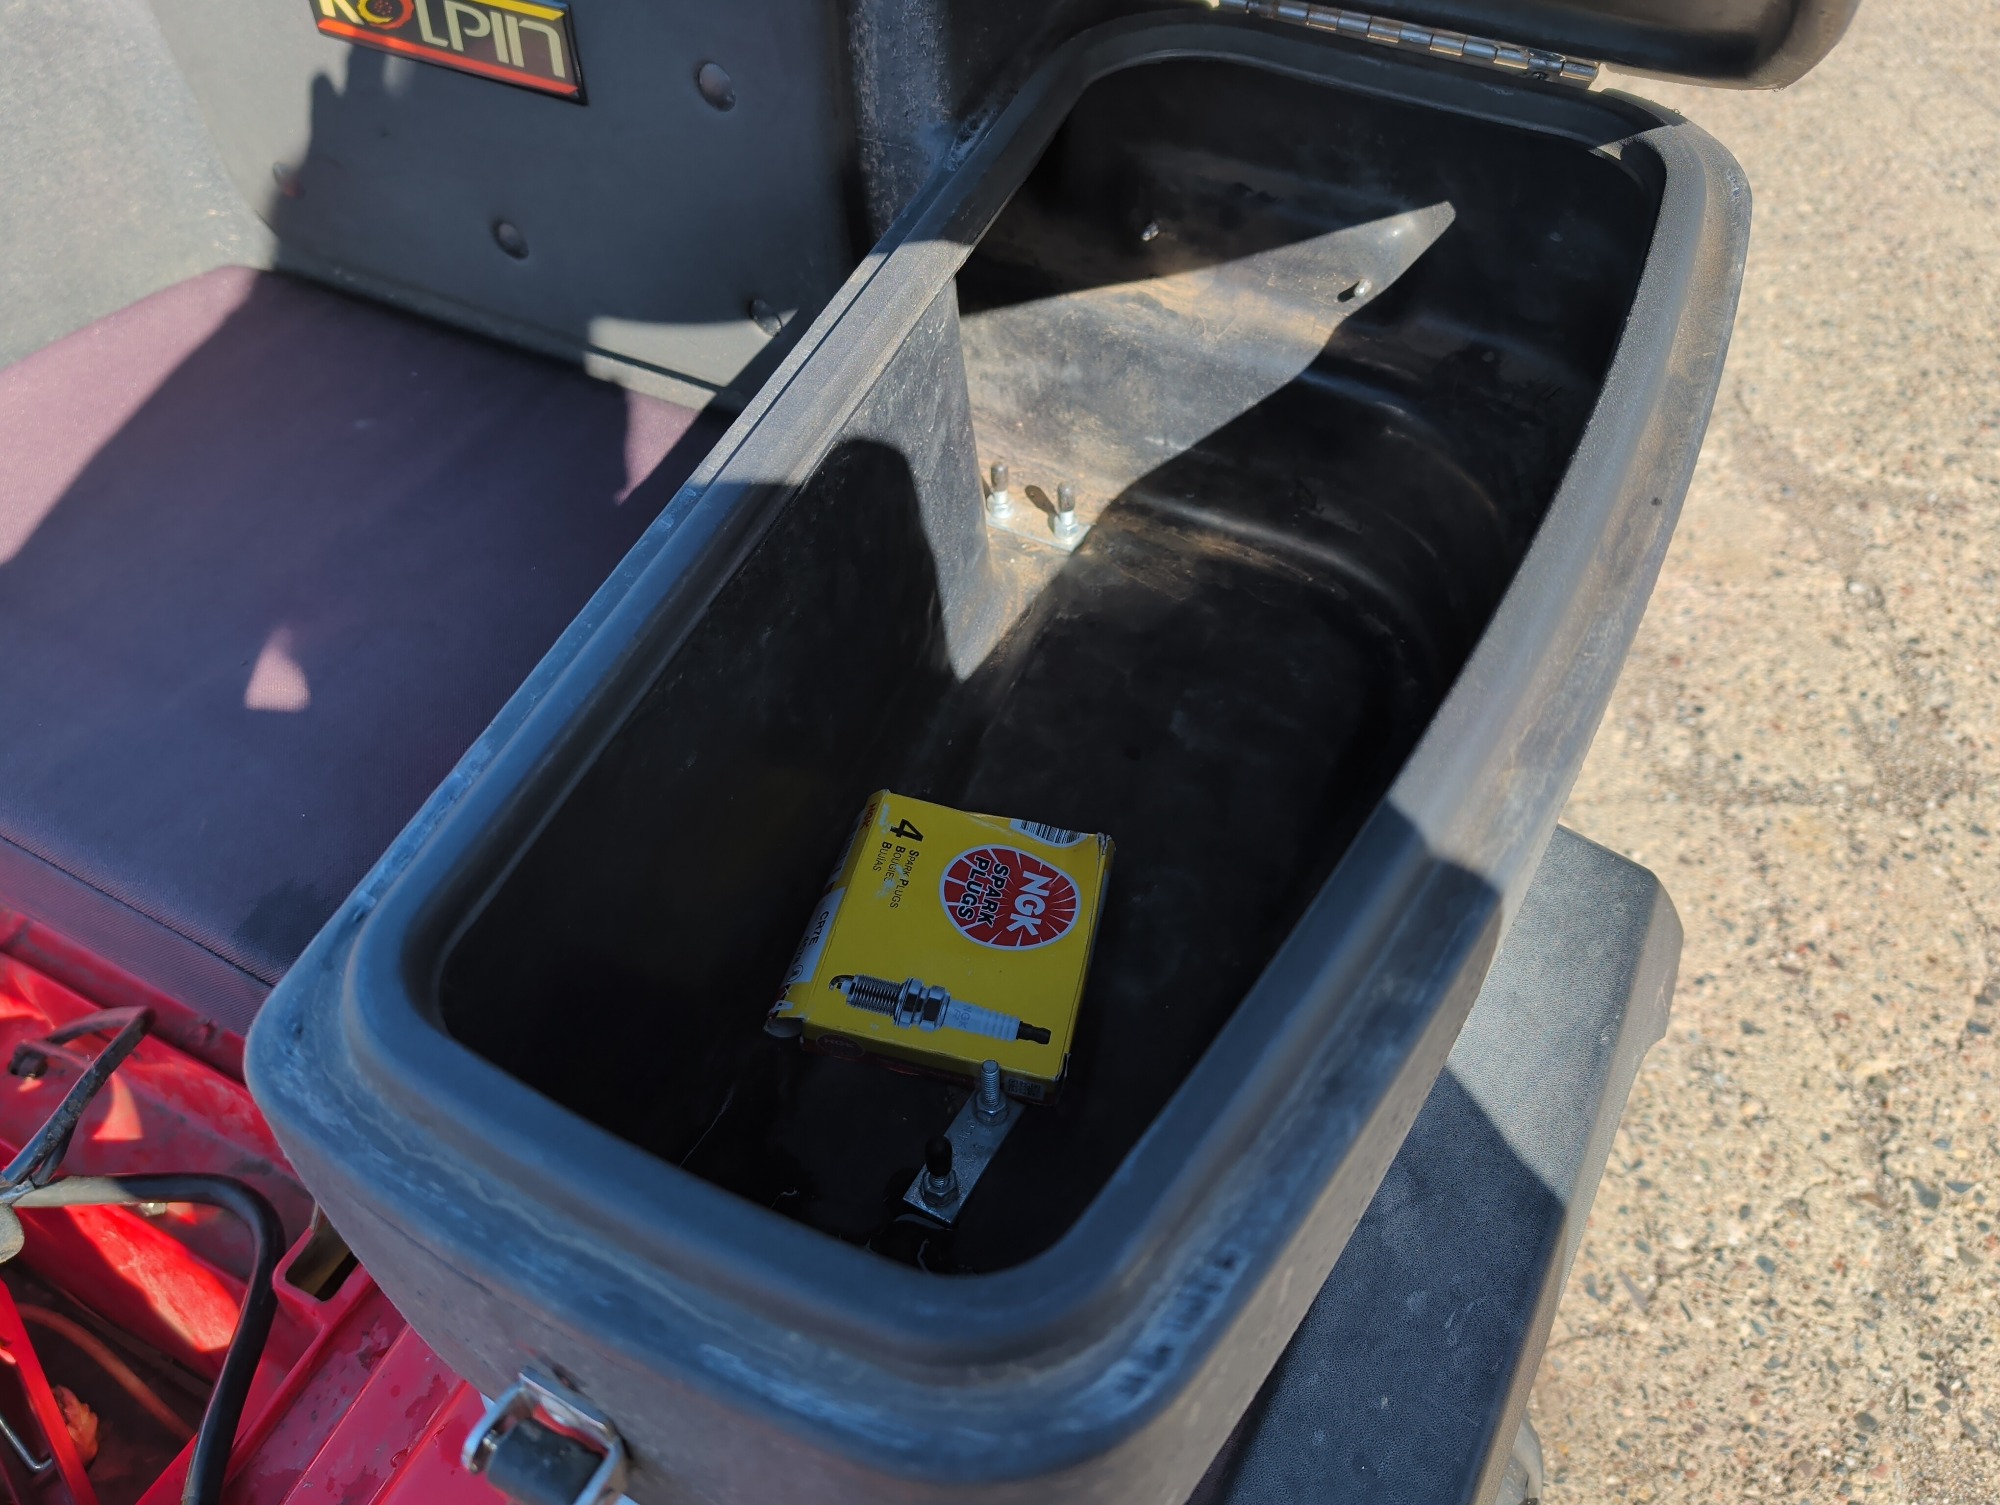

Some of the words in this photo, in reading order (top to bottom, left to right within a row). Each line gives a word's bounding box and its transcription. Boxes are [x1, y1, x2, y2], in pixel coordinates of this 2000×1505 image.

[890, 819, 924, 842] 4
[957, 855, 991, 921] PLUGS
[976, 863, 1010, 928] SPARK
[1006, 870, 1053, 936] NGK
[810, 910, 830, 945] CR7E
[958, 1004, 973, 1029] NGK
